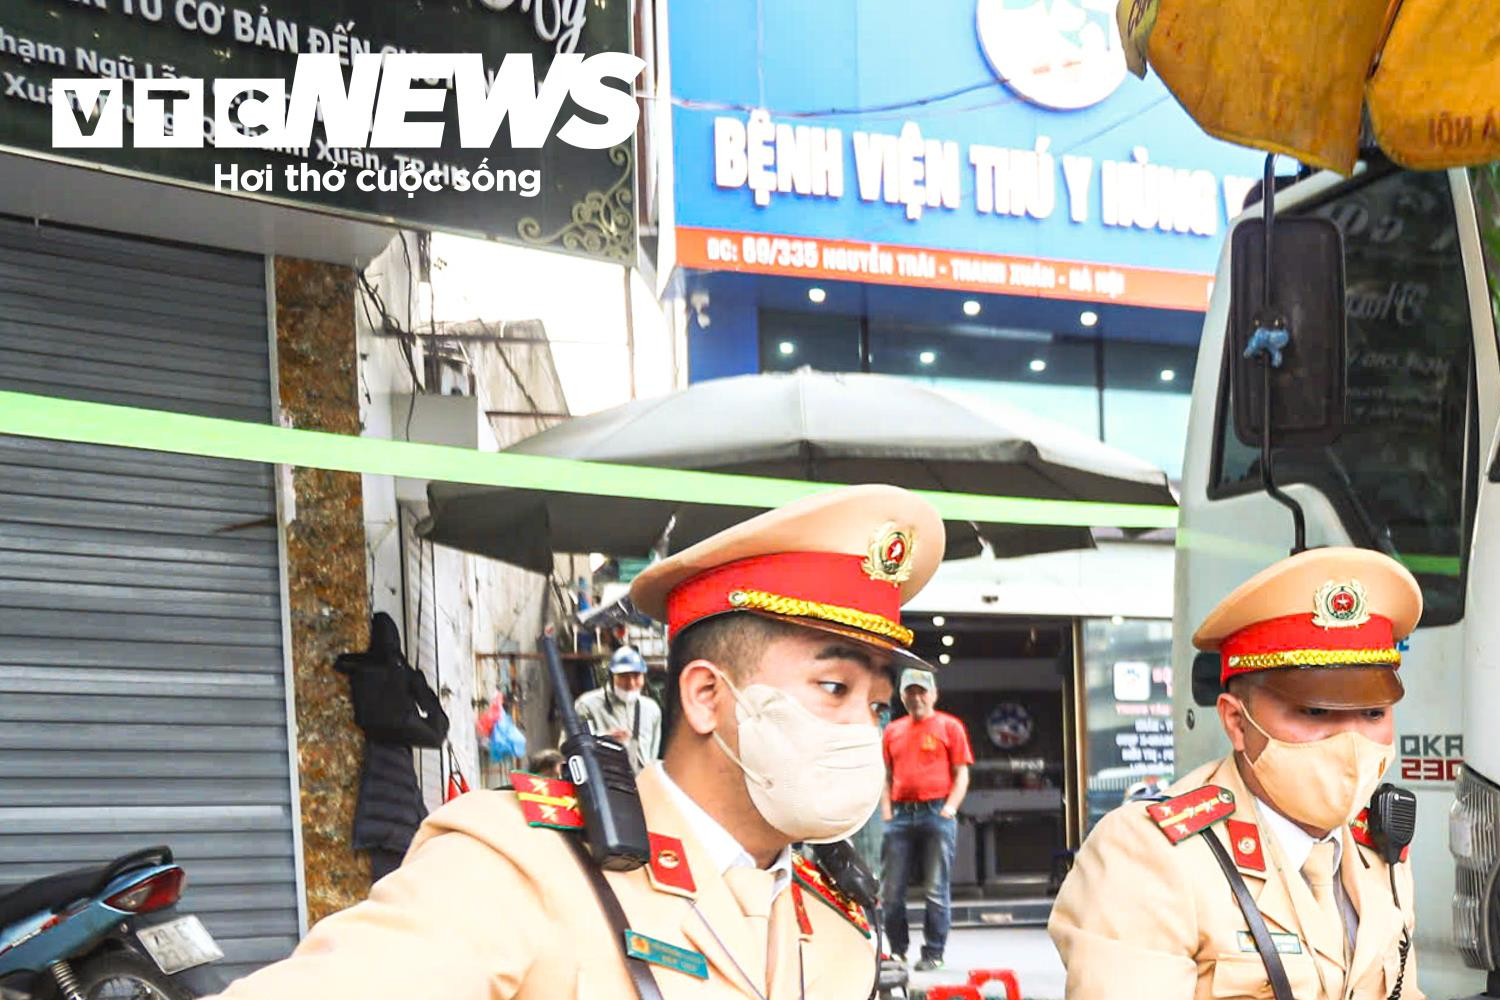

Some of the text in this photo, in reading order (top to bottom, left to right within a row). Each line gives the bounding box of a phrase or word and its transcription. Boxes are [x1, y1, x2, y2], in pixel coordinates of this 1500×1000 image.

[233, 5, 299, 54] BẢN
[713, 108, 844, 207] BỆNH
[852, 120, 961, 221] VIỆN
[968, 134, 1055, 220] THÚ
[1061, 154, 1093, 223] Y
[1400, 735, 1464, 757] QKR
